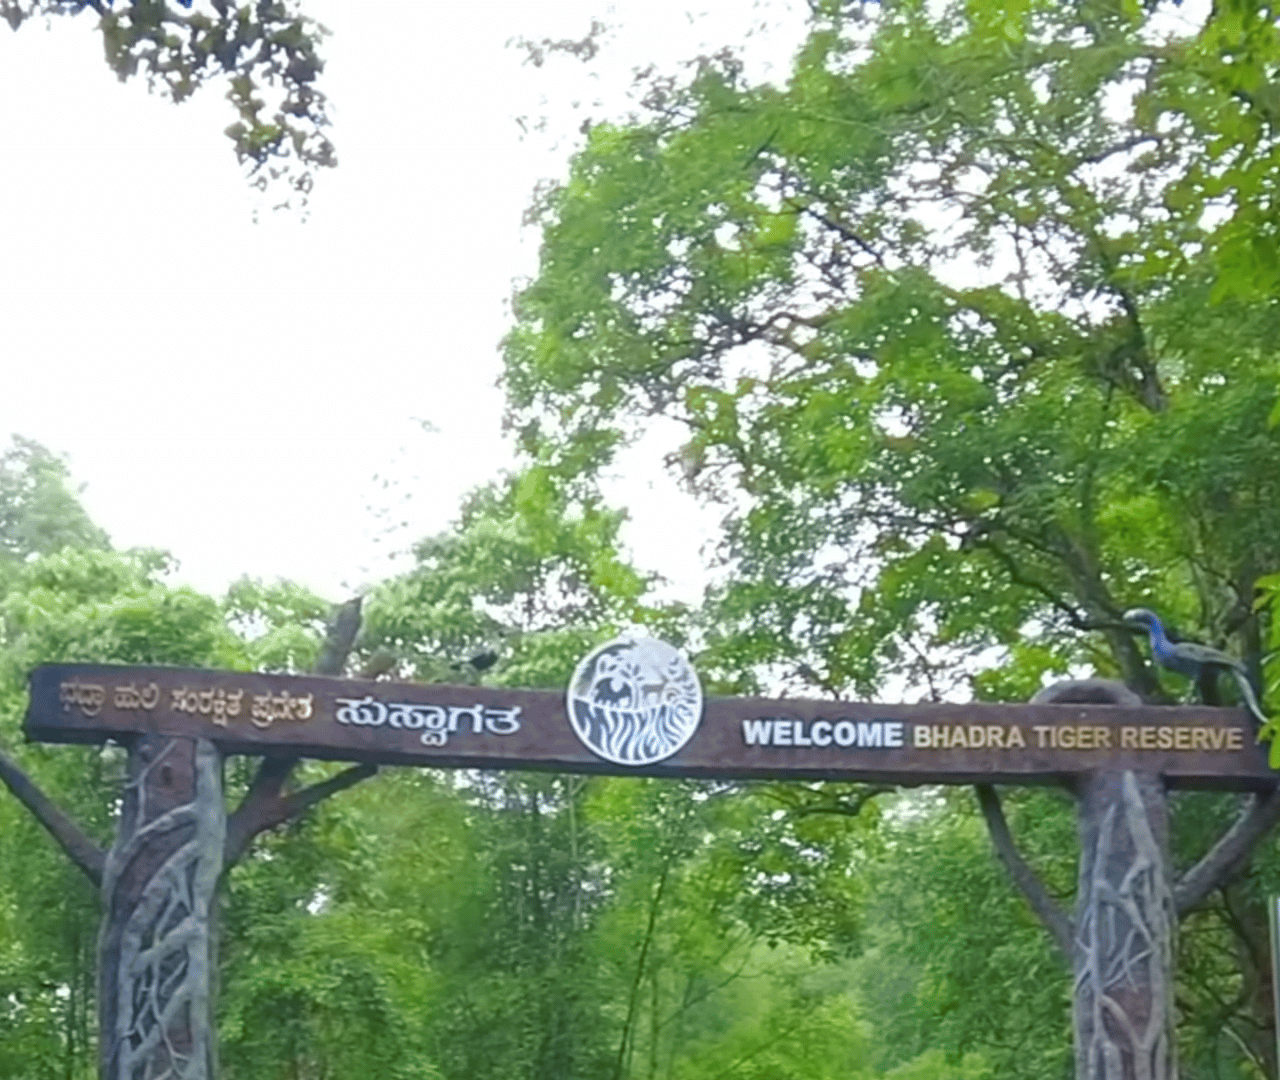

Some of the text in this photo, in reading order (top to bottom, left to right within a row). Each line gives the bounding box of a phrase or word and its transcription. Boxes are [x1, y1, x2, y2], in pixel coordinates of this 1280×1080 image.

[335, 695, 522, 746] ಸುಸ್ವಾಗತ
[742, 719, 1244, 749] WELCOME BHADRA TIGER RESERVE
